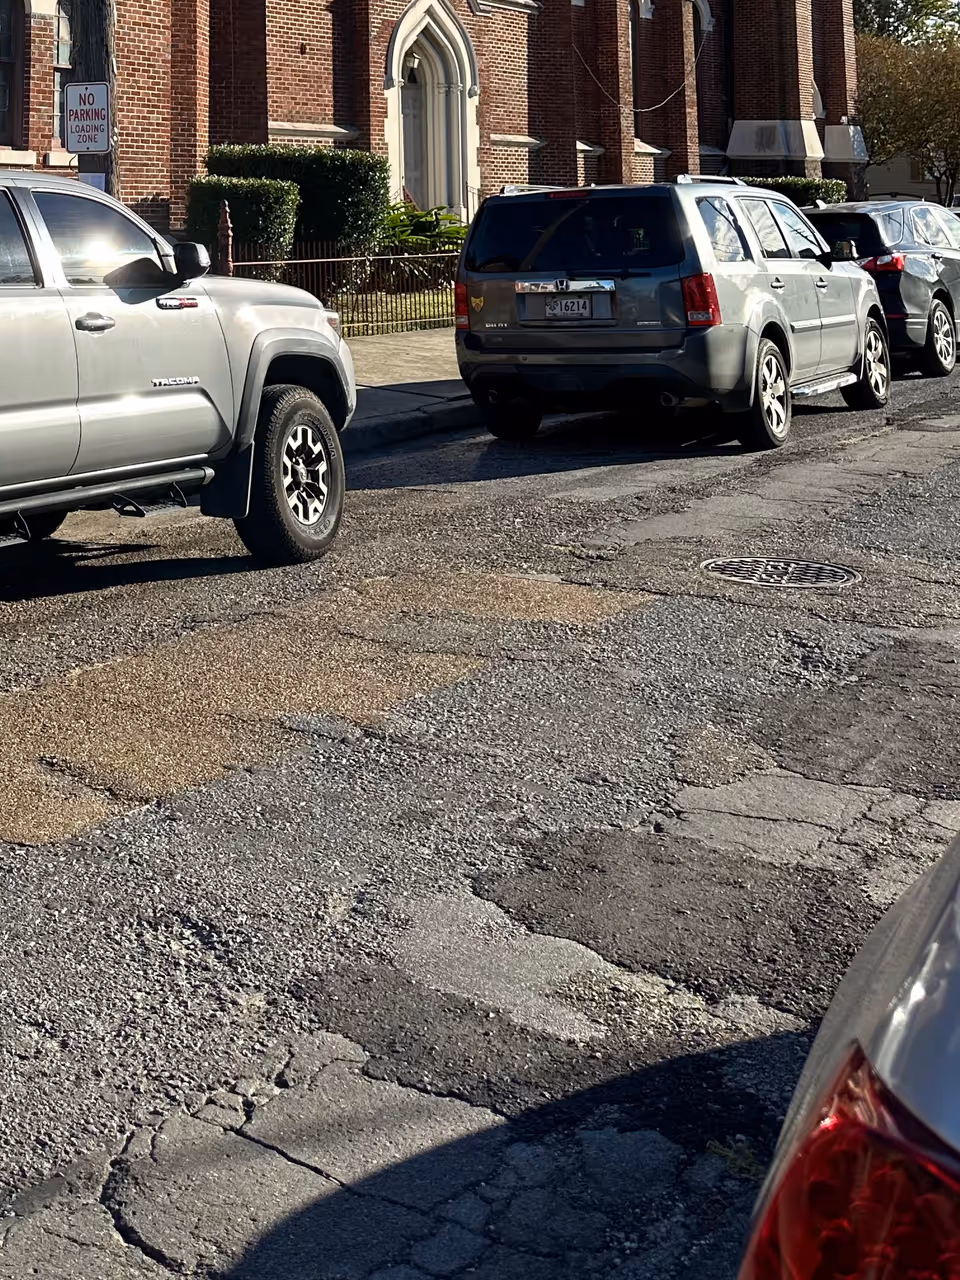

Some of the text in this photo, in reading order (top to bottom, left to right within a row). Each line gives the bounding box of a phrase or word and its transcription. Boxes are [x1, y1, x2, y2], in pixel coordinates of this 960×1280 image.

[79, 93, 95, 106] NO
[69, 108, 106, 121] PARKING
[70, 124, 105, 134] LOADING
[77, 134, 98, 144] ZONE
[560, 301, 587, 312] 16214
[151, 376, 200, 387] TACOMA
